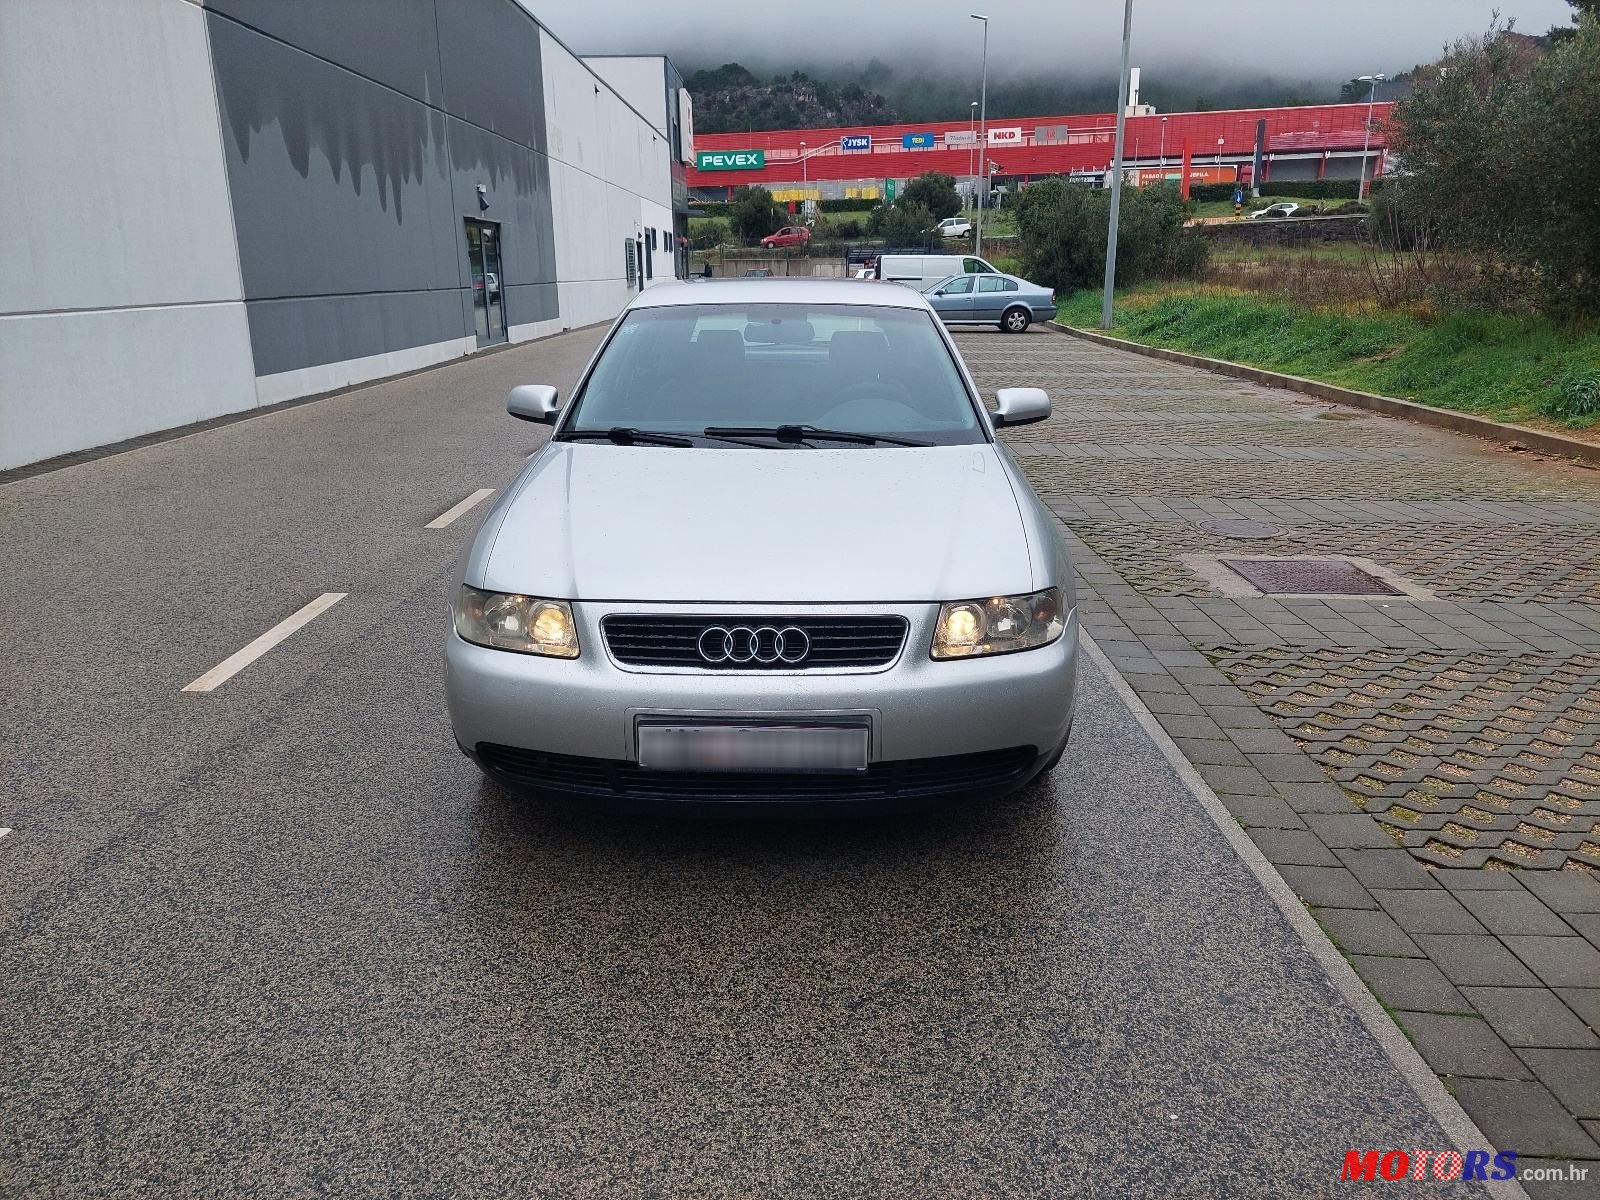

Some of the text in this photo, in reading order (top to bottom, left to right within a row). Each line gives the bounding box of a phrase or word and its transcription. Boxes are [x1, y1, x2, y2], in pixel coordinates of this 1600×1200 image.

[993, 131, 1016, 140] NKD
[848, 138, 867, 147] JYSK
[702, 153, 758, 167] PEVEX
